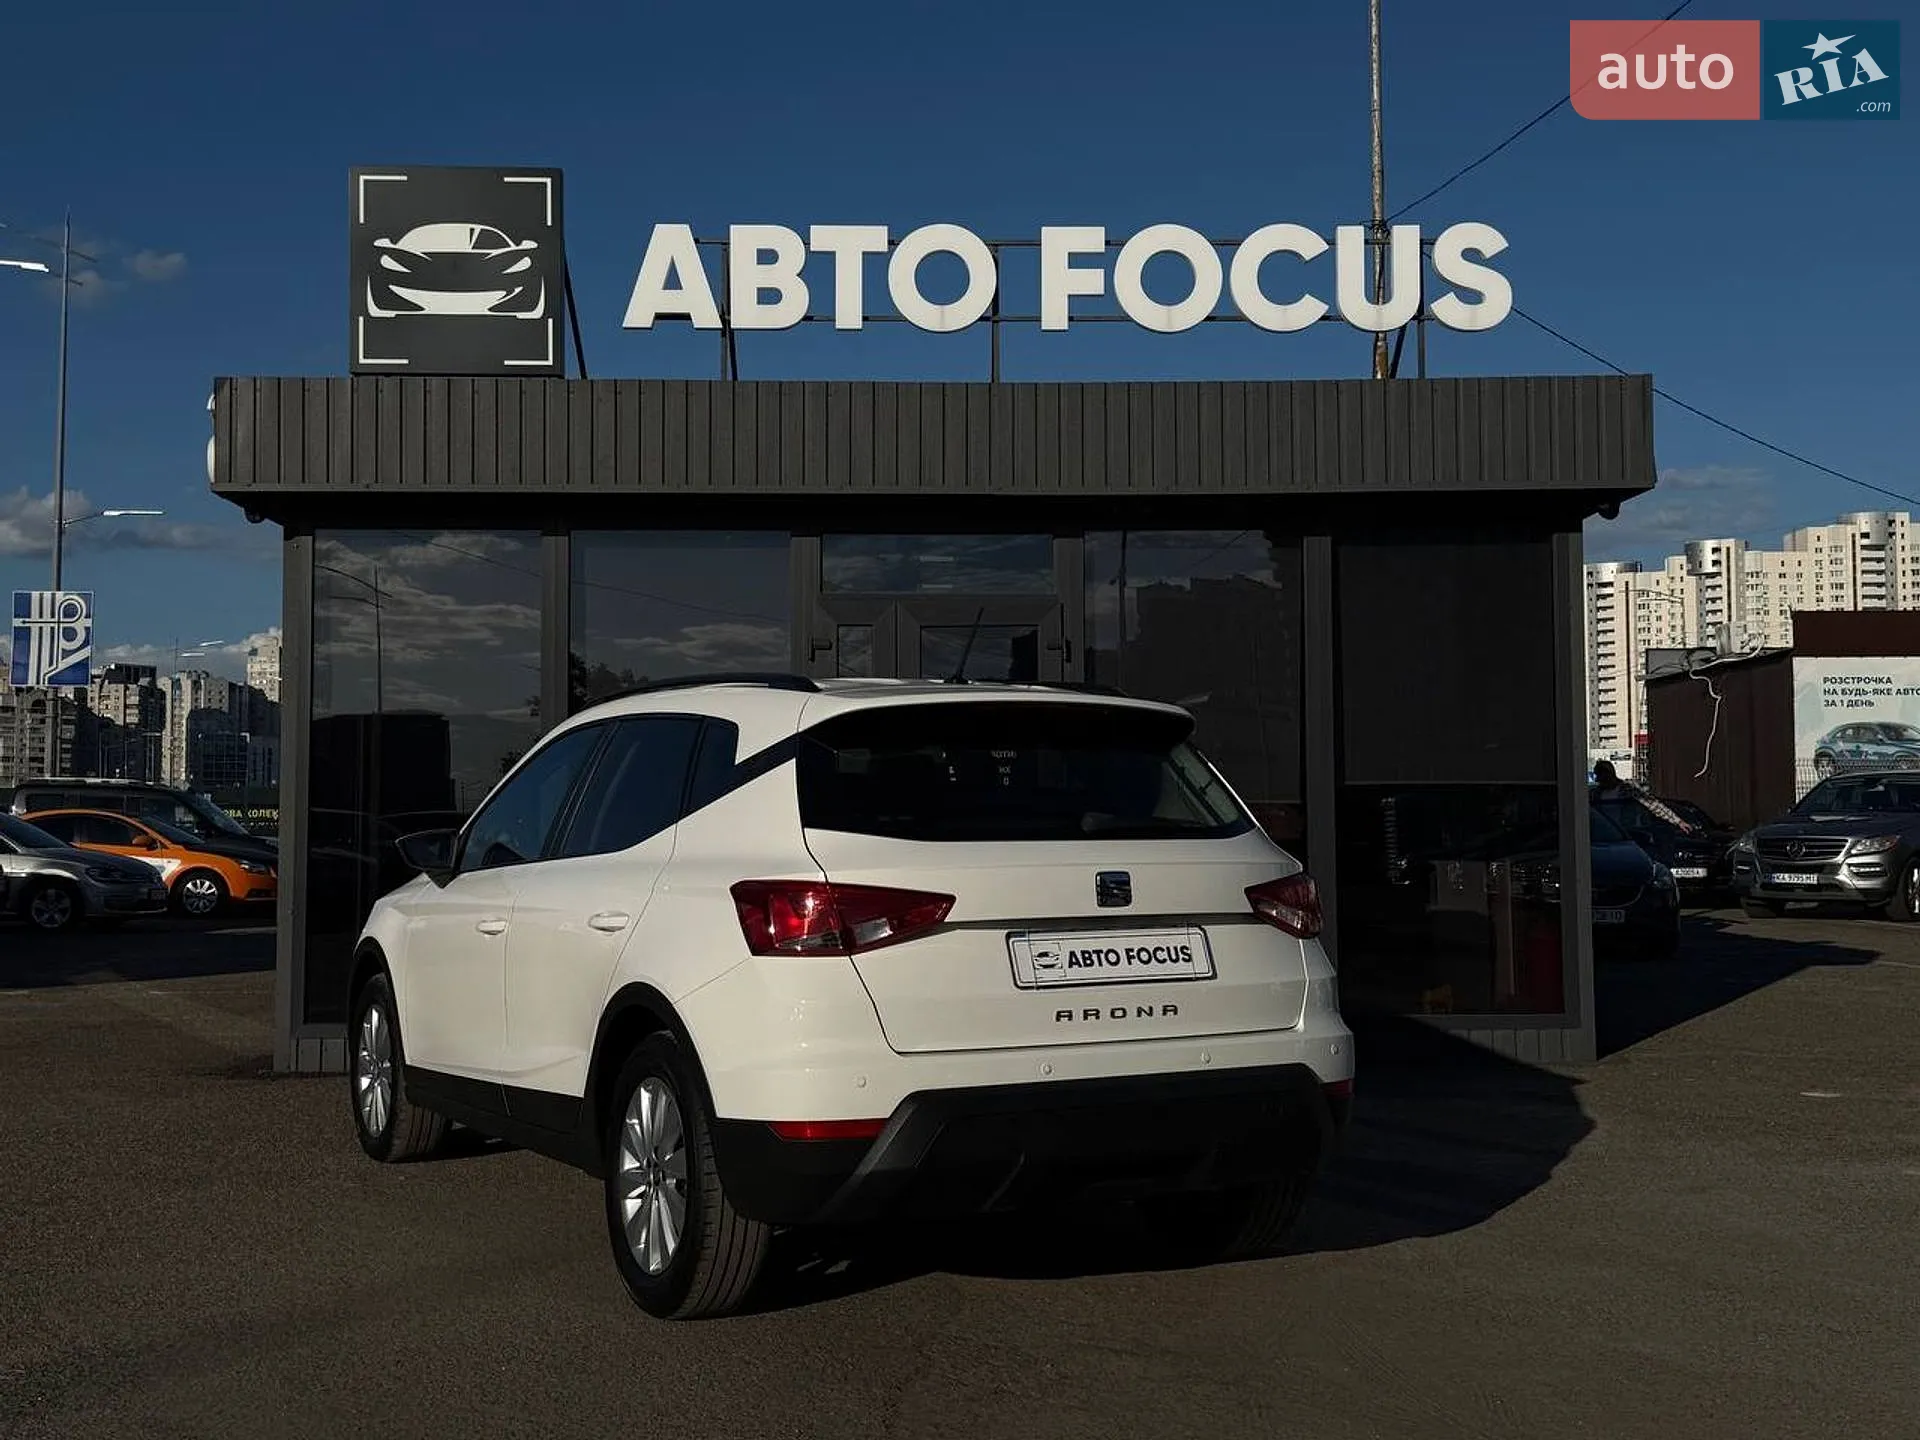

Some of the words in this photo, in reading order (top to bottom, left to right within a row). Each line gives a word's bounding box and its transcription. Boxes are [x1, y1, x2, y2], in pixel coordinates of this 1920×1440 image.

[622, 223, 997, 332] АВТО
[1041, 222, 1512, 332] FOCUS
[1823, 676, 1893, 685] РОЗСТРОЧКА
[1823, 688, 1838, 696] НА
[1841, 688, 1893, 697] БУДЬ-ЯКЕ
[1823, 699, 1837, 707] ЗА
[1846, 699, 1875, 708] ДЕНЬ
[1067, 947, 1121, 969] АВТО
[1125, 945, 1193, 966] FOCUS
[1055, 1004, 1179, 1022] ARONA
